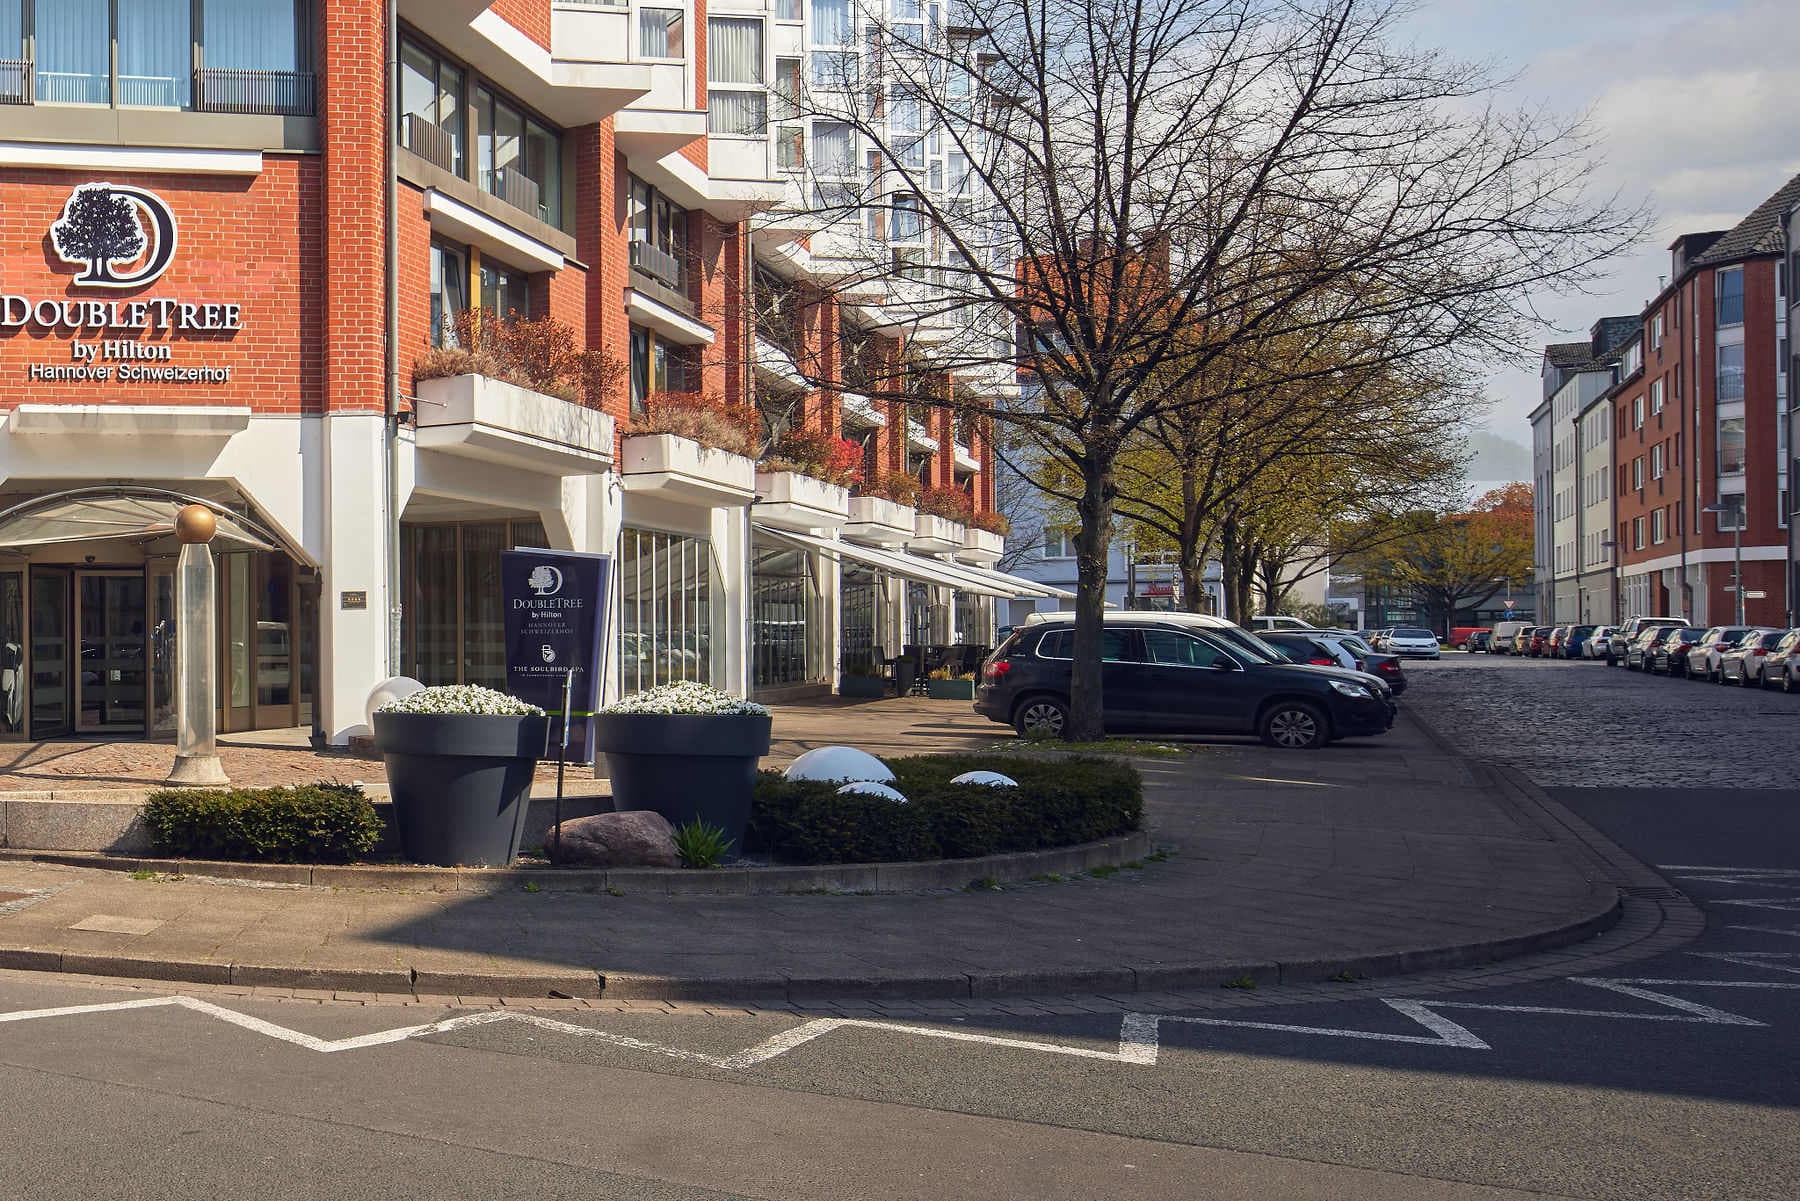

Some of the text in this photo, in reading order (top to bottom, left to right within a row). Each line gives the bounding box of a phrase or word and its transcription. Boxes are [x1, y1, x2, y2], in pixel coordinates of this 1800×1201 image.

[0, 294, 243, 331] DOUBLETREE
[73, 339, 172, 363] by Hilton
[30, 363, 231, 382] Hannover Schweizerhof
[513, 597, 584, 609] DOUBLETREE
[531, 611, 562, 619] by Hilton
